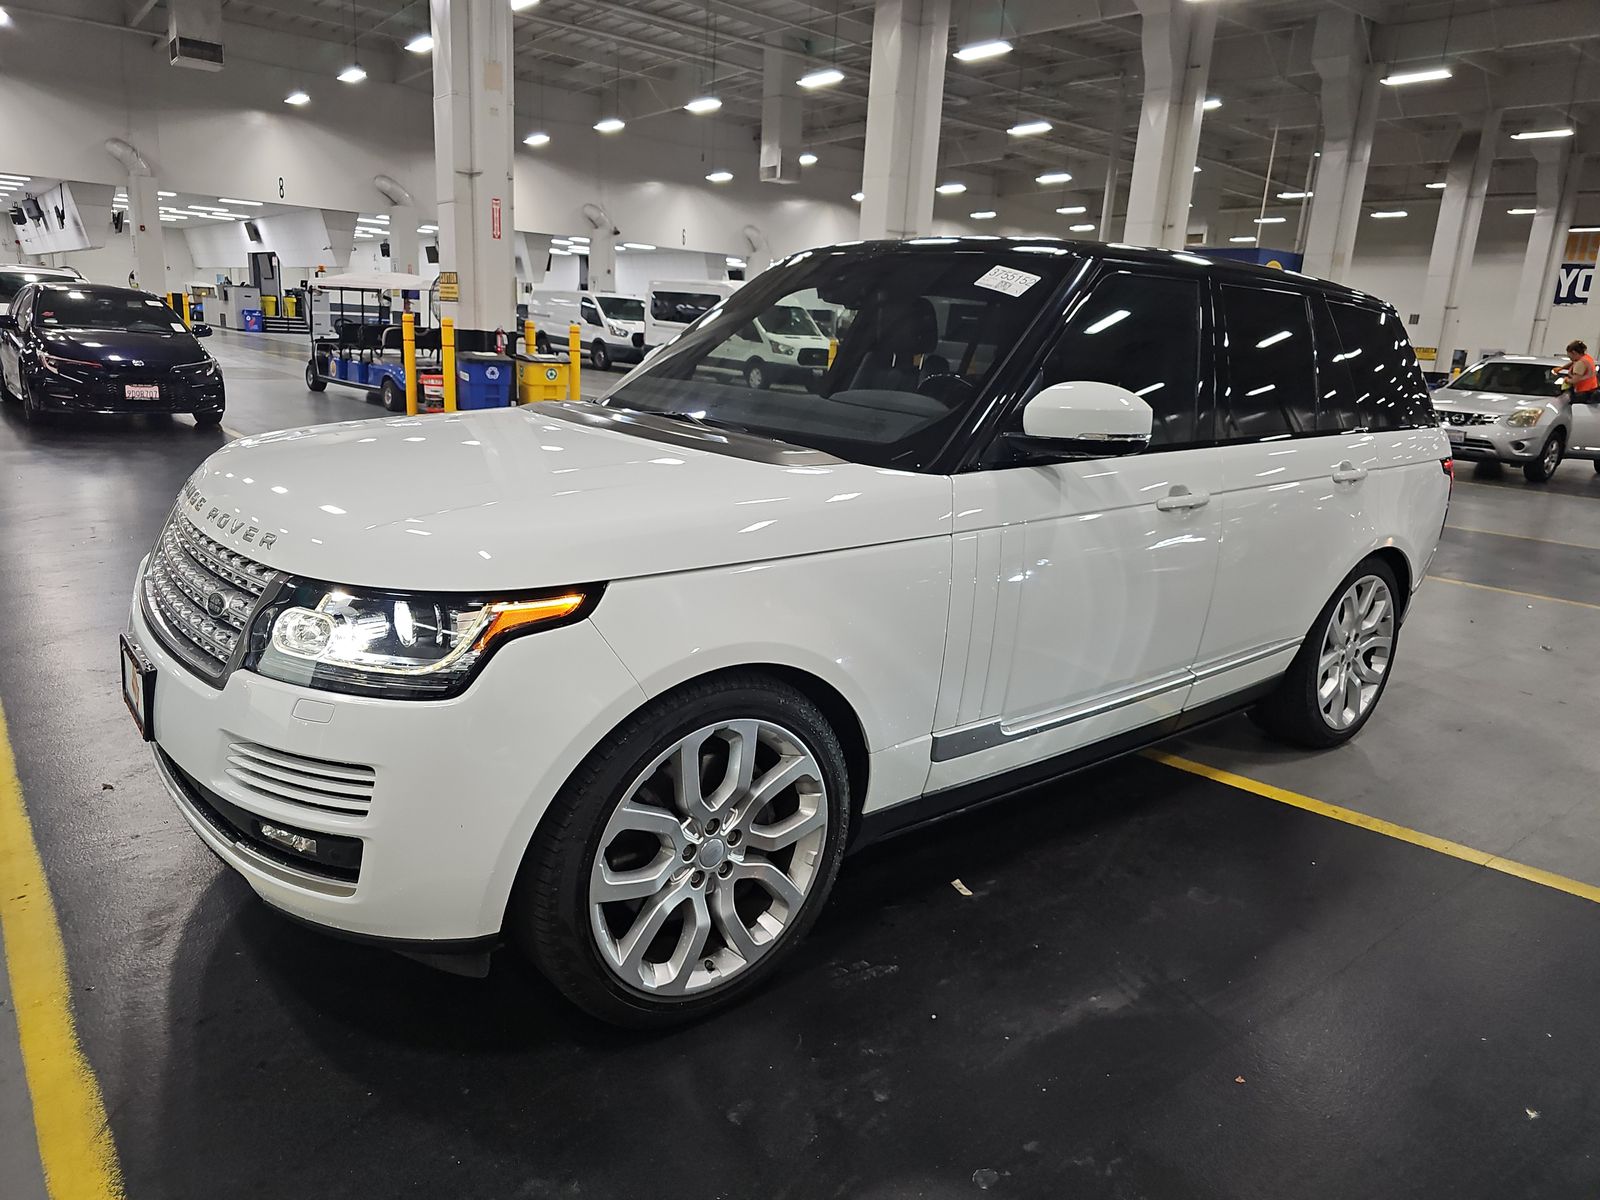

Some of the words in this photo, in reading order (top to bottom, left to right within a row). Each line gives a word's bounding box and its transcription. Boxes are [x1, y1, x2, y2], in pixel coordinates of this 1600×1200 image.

[278, 177, 285, 199] 8
[988, 268, 1037, 287] 3755152
[206, 506, 278, 550] ROVER
